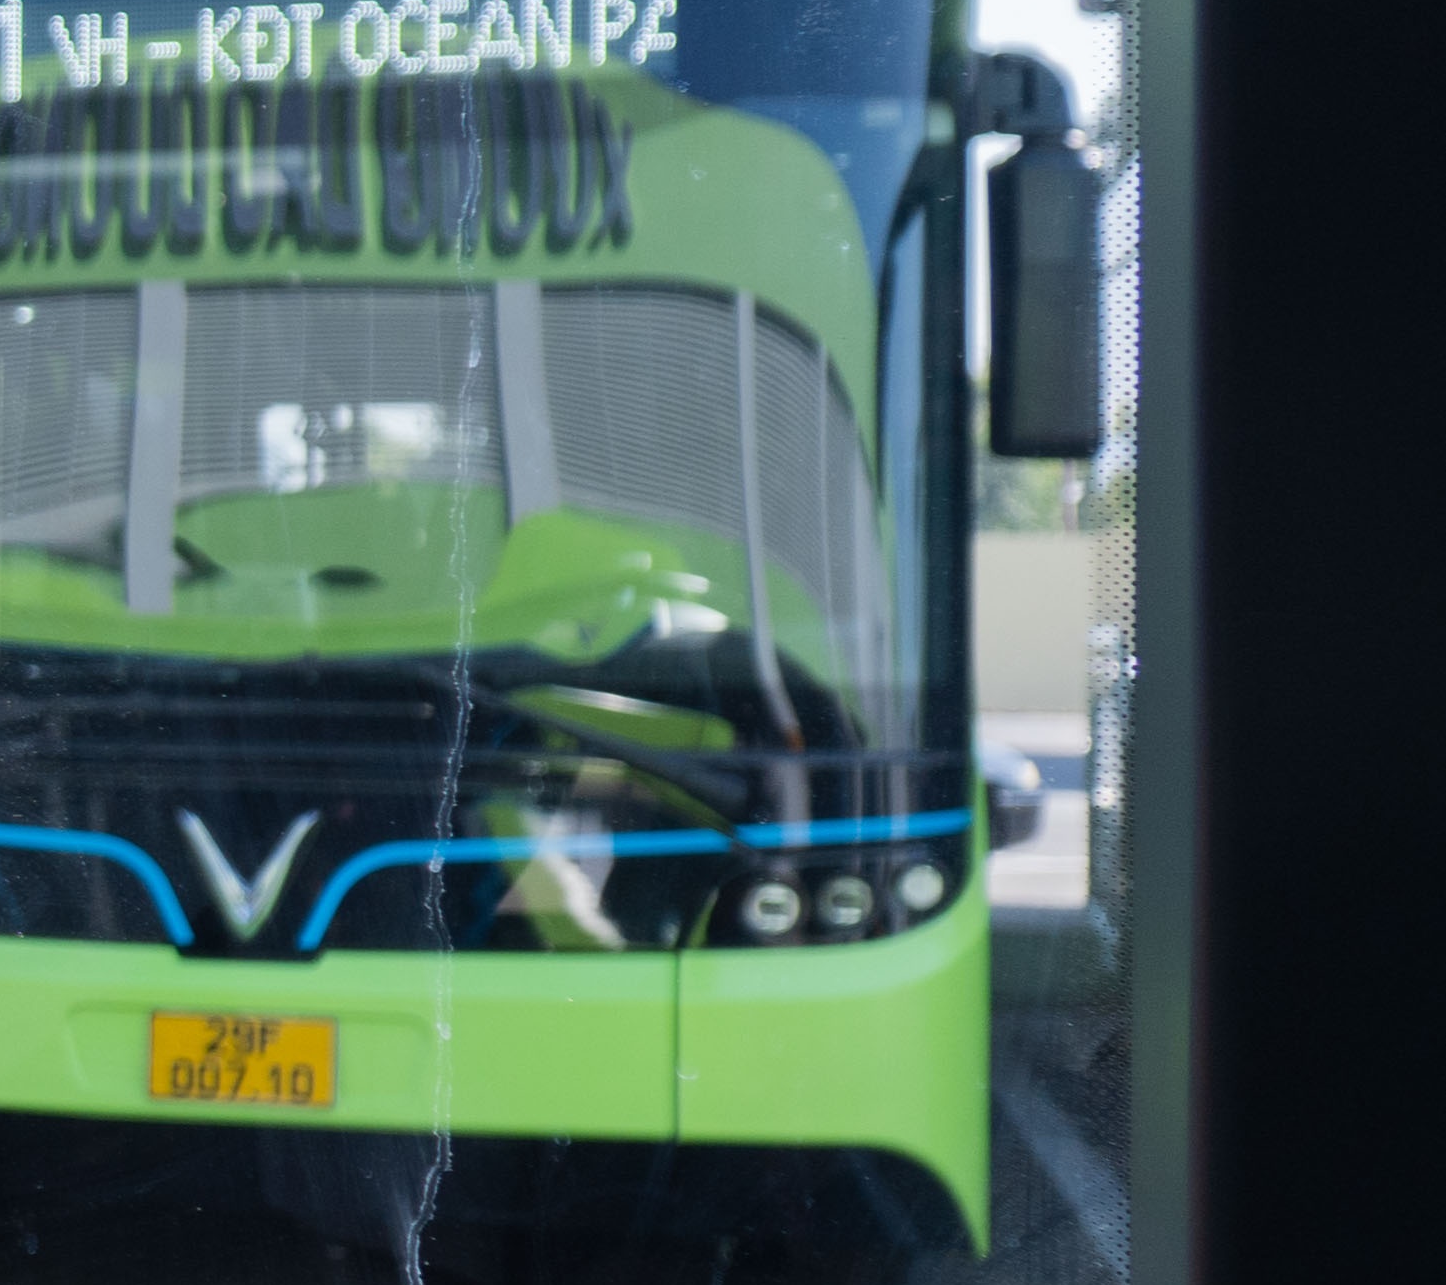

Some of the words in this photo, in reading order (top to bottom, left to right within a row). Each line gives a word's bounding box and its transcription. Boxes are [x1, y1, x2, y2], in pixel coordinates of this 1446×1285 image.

[197, 2, 324, 83] KĐT
[205, 1016, 281, 1055] 29F
[171, 1058, 316, 1105] 007.10
